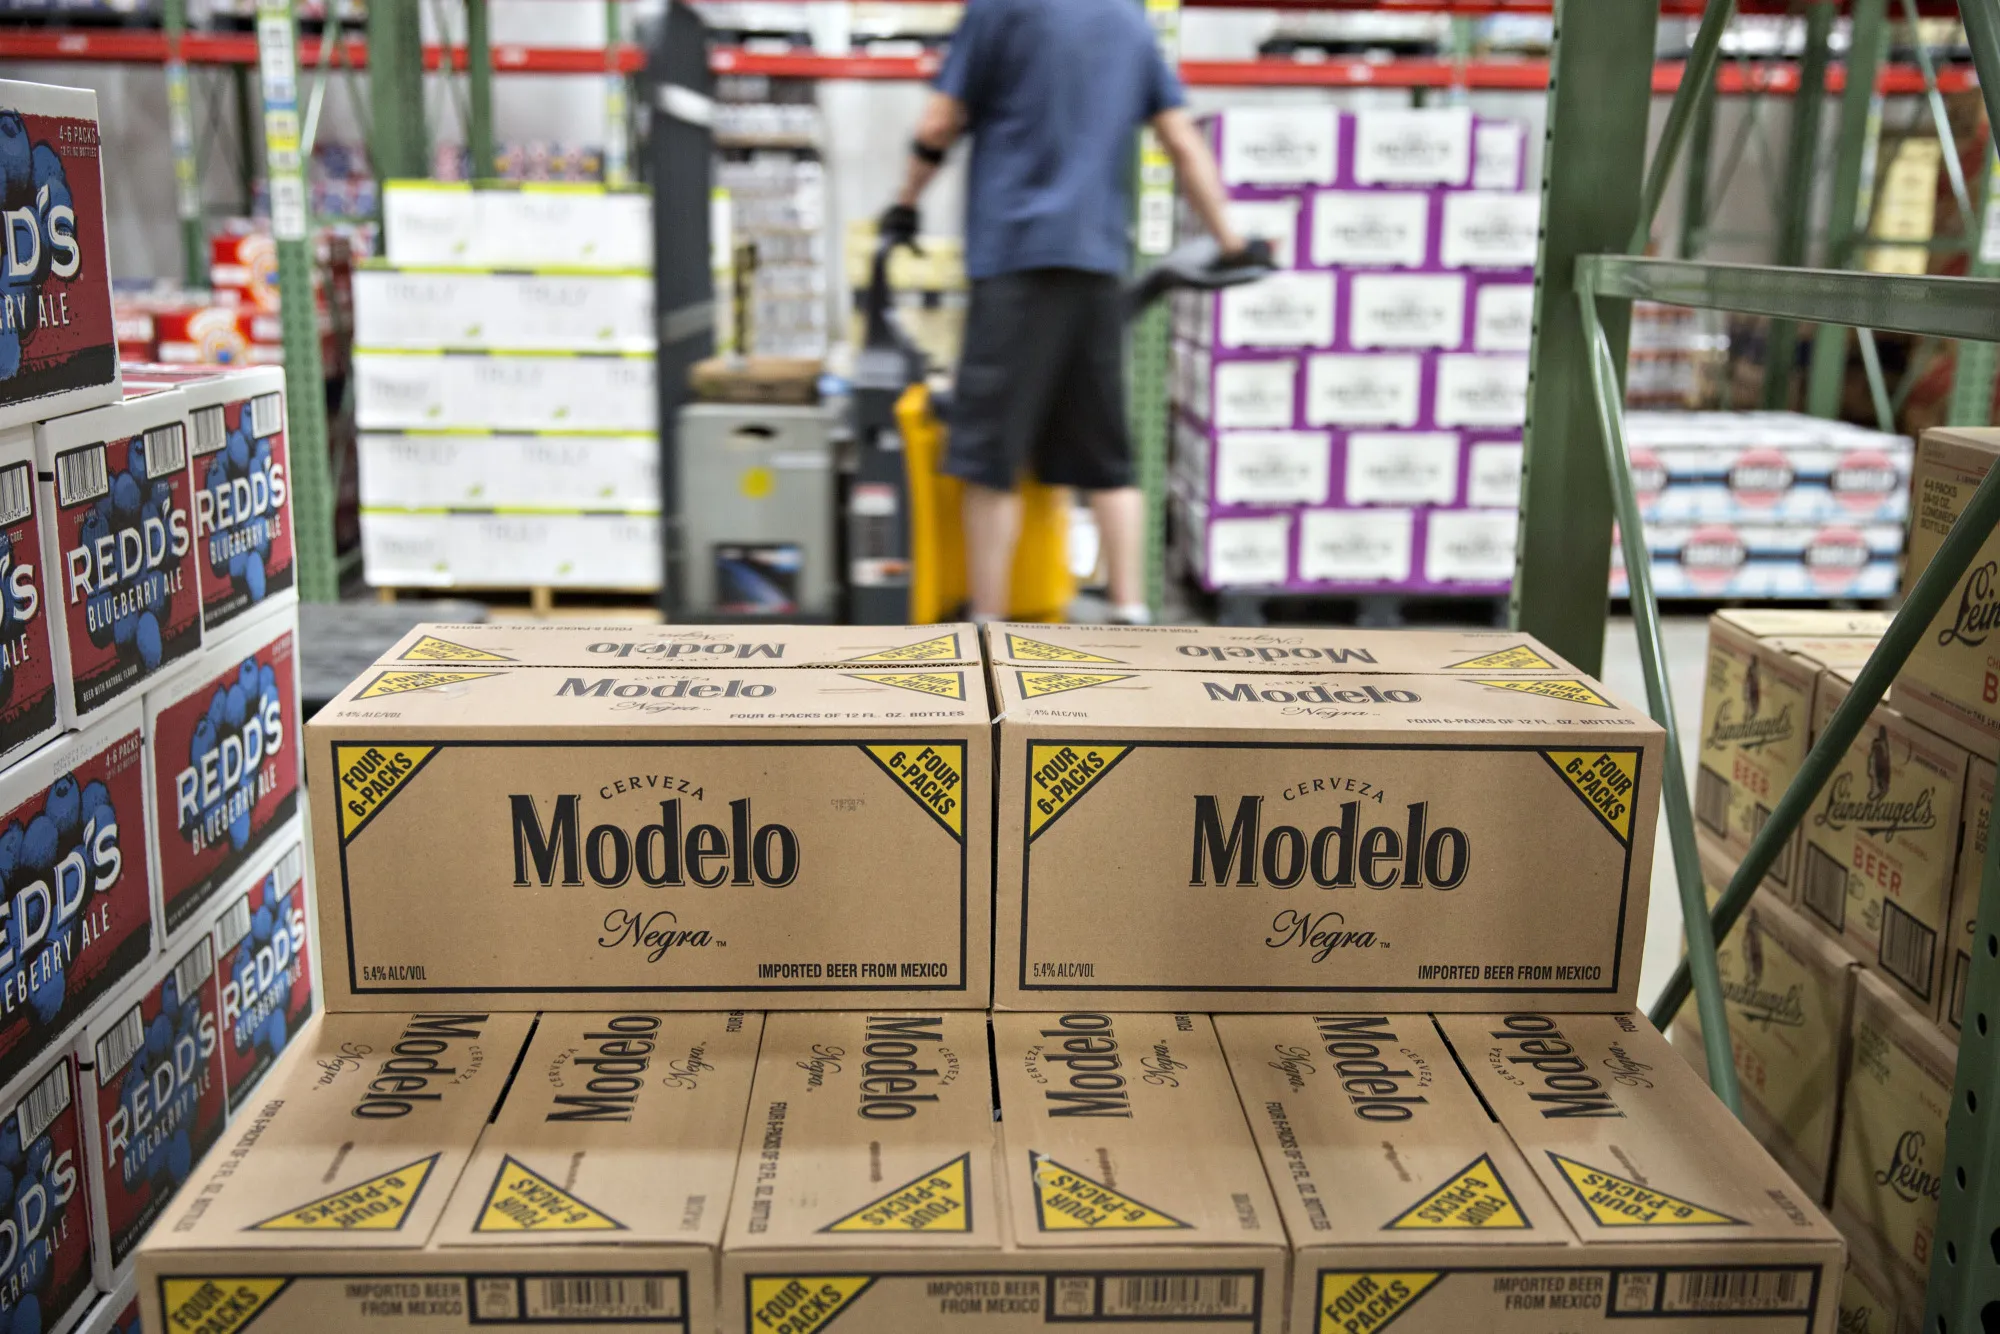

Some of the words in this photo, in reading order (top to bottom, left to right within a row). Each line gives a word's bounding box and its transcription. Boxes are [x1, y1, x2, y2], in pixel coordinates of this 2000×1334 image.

[58, 126, 73, 142] 4-6
[74, 127, 96, 144] PACKS
[38, 292, 70, 329] ALE
[195, 455, 287, 537] REDD'S
[1935, 481, 1958, 498] PACKS
[66, 495, 190, 605] REDD'S
[209, 526, 263, 565] BLUEBERRY
[87, 578, 164, 633] BLUEBERRY
[163, 566, 184, 597] ALE
[3, 632, 30, 670] ALE
[586, 642, 787, 659] Modelo
[1176, 644, 1378, 664] Modelo
[384, 672, 434, 686] FOUR
[556, 677, 777, 699] Modelo
[878, 676, 954, 696] 6-PACKS
[910, 674, 956, 686] FOUR
[1026, 673, 1074, 686] FOUR
[1032, 675, 1102, 694] 6-PACKS
[1201, 682, 1422, 704] Modelo
[1264, 680, 1340, 688] CERVEZA
[1504, 682, 1592, 702] 6-PACKS
[1532, 680, 1588, 692] FOUR
[608, 701, 703, 714] Negra
[768, 712, 821, 720] 6-PACKS
[909, 710, 966, 718] BOTTLES
[1280, 706, 1370, 720] Negra
[105, 750, 118, 768] 4-6
[118, 735, 140, 759] PACKS
[176, 692, 283, 830] REDD'S
[342, 748, 386, 791] FOUR
[916, 746, 960, 790] FOUR
[1033, 746, 1080, 790] FOUR
[348, 752, 413, 818] 6-PACKS
[599, 774, 706, 801] CERVEZA
[888, 751, 956, 816] 6-PACKS
[1036, 751, 1105, 816] 6-PACKS
[1283, 778, 1384, 803] CERVEZA
[1565, 757, 1626, 820] 6-PACKS
[1592, 754, 1632, 797] FOUR
[1733, 760, 1770, 795] BEER
[192, 782, 255, 856] BLUEBERRY
[258, 764, 277, 799] ALE
[1814, 770, 1936, 843] Leinenkugel's
[508, 794, 800, 889] Modelo
[1188, 794, 1470, 890] Modelo
[1852, 846, 1904, 897] BEER
[82, 902, 111, 951] ALE
[598, 908, 713, 964] Negra
[1266, 909, 1378, 964] Negra
[221, 907, 306, 1030] REDD'S
[363, 966, 387, 981] 5.4%
[388, 965, 426, 980] ALC/VOL
[758, 964, 822, 978] IMPORTED
[826, 964, 858, 978] BEER
[861, 963, 897, 978] FROM
[900, 962, 948, 978] MEXICO
[1034, 962, 1056, 978] 5.4%
[1057, 962, 1095, 978] ALC/VOL
[1418, 966, 1480, 980] IMPORTED
[1484, 966, 1514, 980] BEER
[1517, 966, 1552, 980] FROM
[1555, 966, 1601, 980] MEXICO
[234, 976, 286, 1049] BLUEBERRY
[726, 1016, 745, 1033] FOUR
[1176, 1015, 1194, 1032] FOUR
[1614, 1014, 1640, 1034] FOUR
[317, 1042, 373, 1086] Negra
[352, 1012, 489, 1119] Modelo
[449, 1045, 482, 1086] CERVEZA
[544, 1016, 662, 1122] Modelo
[548, 1048, 580, 1088] CERVEZA
[662, 1045, 714, 1090] Negra
[796, 1044, 846, 1086] Negra
[858, 1016, 944, 1120] Modelo
[938, 1046, 960, 1087] CERVEZA
[1024, 1044, 1048, 1084] CERVEZA
[1038, 1014, 1134, 1119] Modelo
[1140, 1044, 1188, 1088] Negra
[1268, 1044, 1316, 1088] Negra
[1312, 1016, 1430, 1122] Modelo
[1400, 1048, 1432, 1088] CERVEZA
[1488, 1046, 1526, 1086] CERVEZA
[1488, 1014, 1628, 1120] Modelo
[1602, 1046, 1654, 1090] Negra
[105, 1010, 216, 1170] REDD'S
[122, 1089, 190, 1183] BLUEBERRY
[294, 1177, 406, 1224] 6-PACKS
[333, 1196, 404, 1227] FOUR
[492, 1196, 548, 1230] FOUR
[508, 1178, 589, 1224] 6-PACKS
[860, 1177, 952, 1226] 6-PACKS
[900, 1196, 961, 1230] FOUR
[1046, 1194, 1107, 1228] FOUR
[1050, 1174, 1146, 1222] 6-PACKS
[1416, 1176, 1489, 1224] 6-PACKS
[1456, 1194, 1507, 1226] FOUR
[1582, 1172, 1694, 1218] 6-PACKS
[1598, 1192, 1659, 1222] FOUR
[345, 1284, 422, 1299] IMPORTED
[426, 1282, 460, 1298] BEER
[756, 1278, 811, 1329] FOUR
[926, 1282, 1000, 1296] IMPORTED
[1004, 1281, 1040, 1295] BEER
[1326, 1276, 1380, 1323] FOUR
[1494, 1278, 1565, 1292] IMPORTED
[1568, 1278, 1604, 1291] BEER
[1505, 1294, 1547, 1309] FROM
[1550, 1294, 1602, 1308] MEXICO
[172, 1280, 227, 1331] FOUR
[361, 1302, 408, 1317] FROM
[412, 1302, 462, 1316] MEXICO
[940, 1298, 982, 1314] FROM
[985, 1298, 1040, 1313] MEXICO
